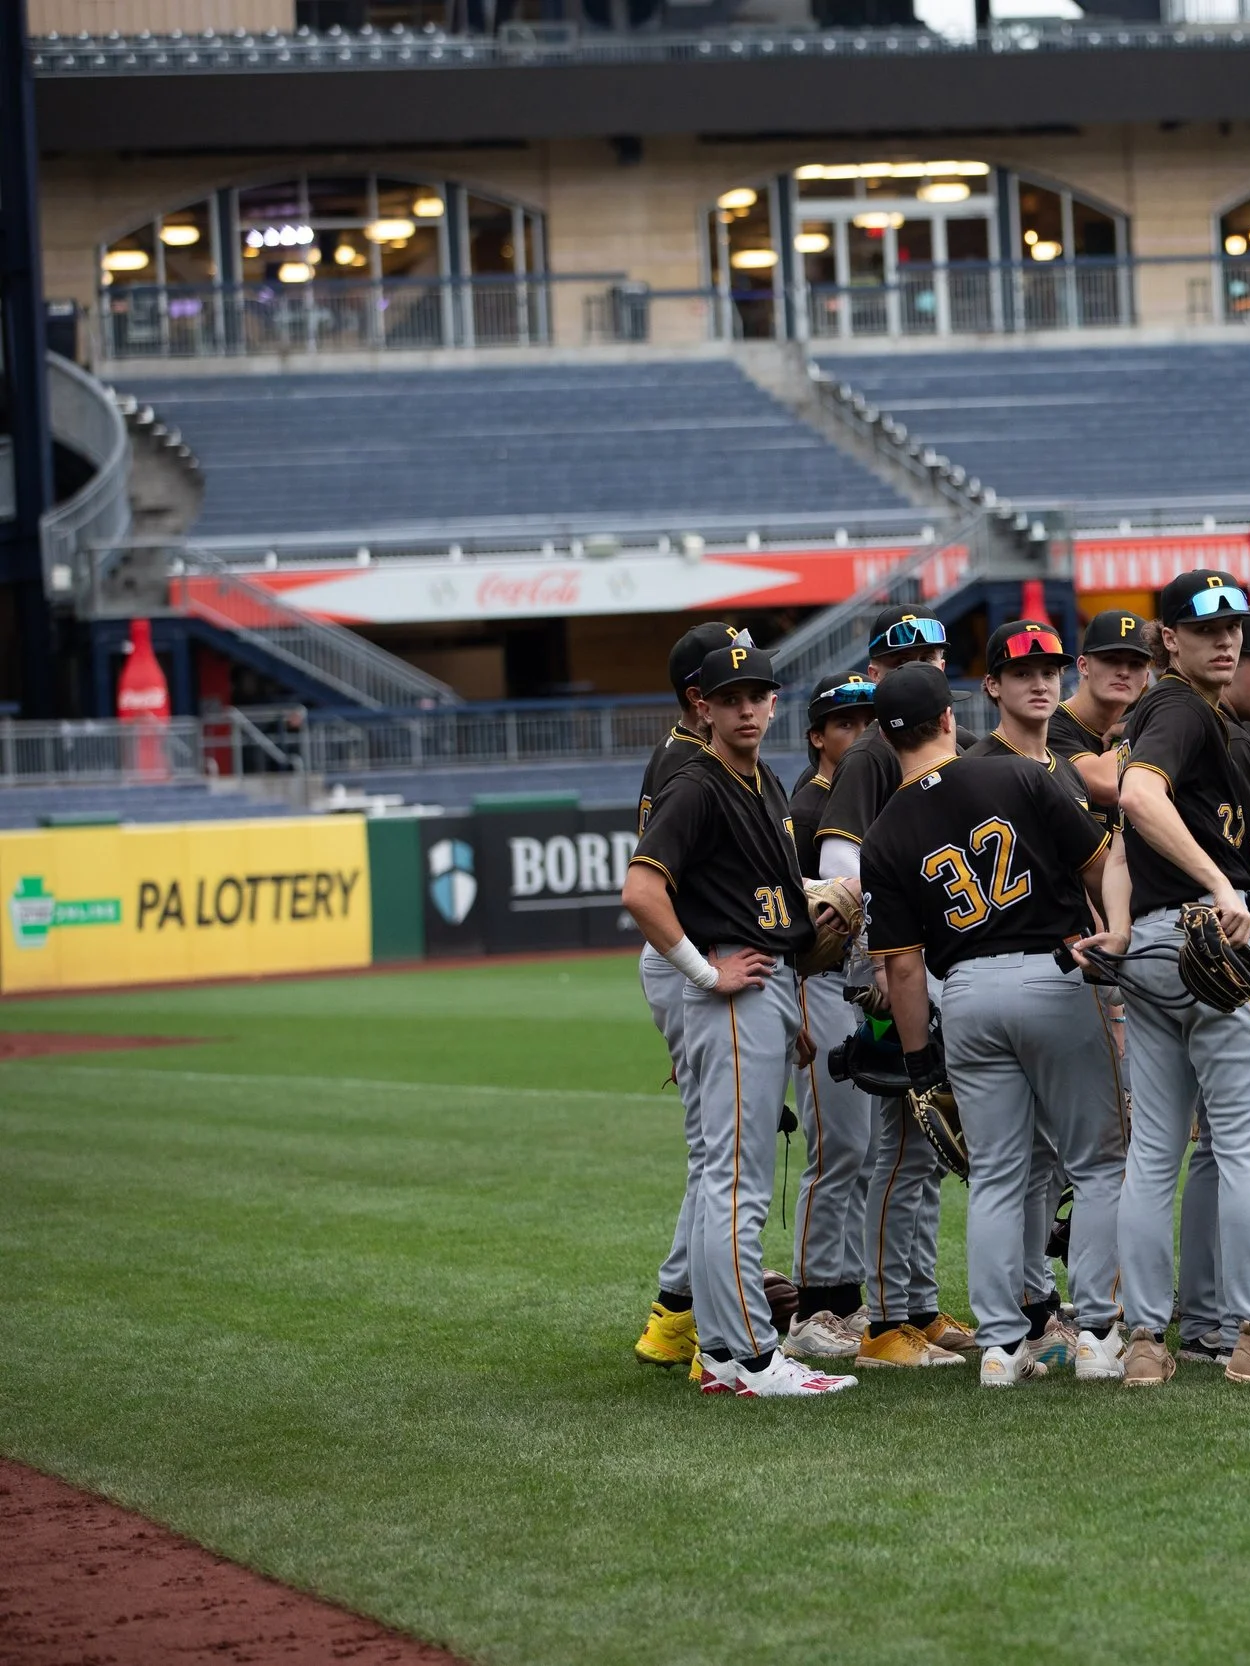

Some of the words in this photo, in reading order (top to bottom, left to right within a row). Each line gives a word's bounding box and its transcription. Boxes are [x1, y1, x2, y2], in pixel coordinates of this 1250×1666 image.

[1120, 617, 1135, 637] P
[731, 648, 748, 670] P
[920, 815, 1032, 933] 32
[136, 879, 187, 932] PA
[196, 869, 362, 928] LOTTERY
[754, 885, 792, 930] 31
